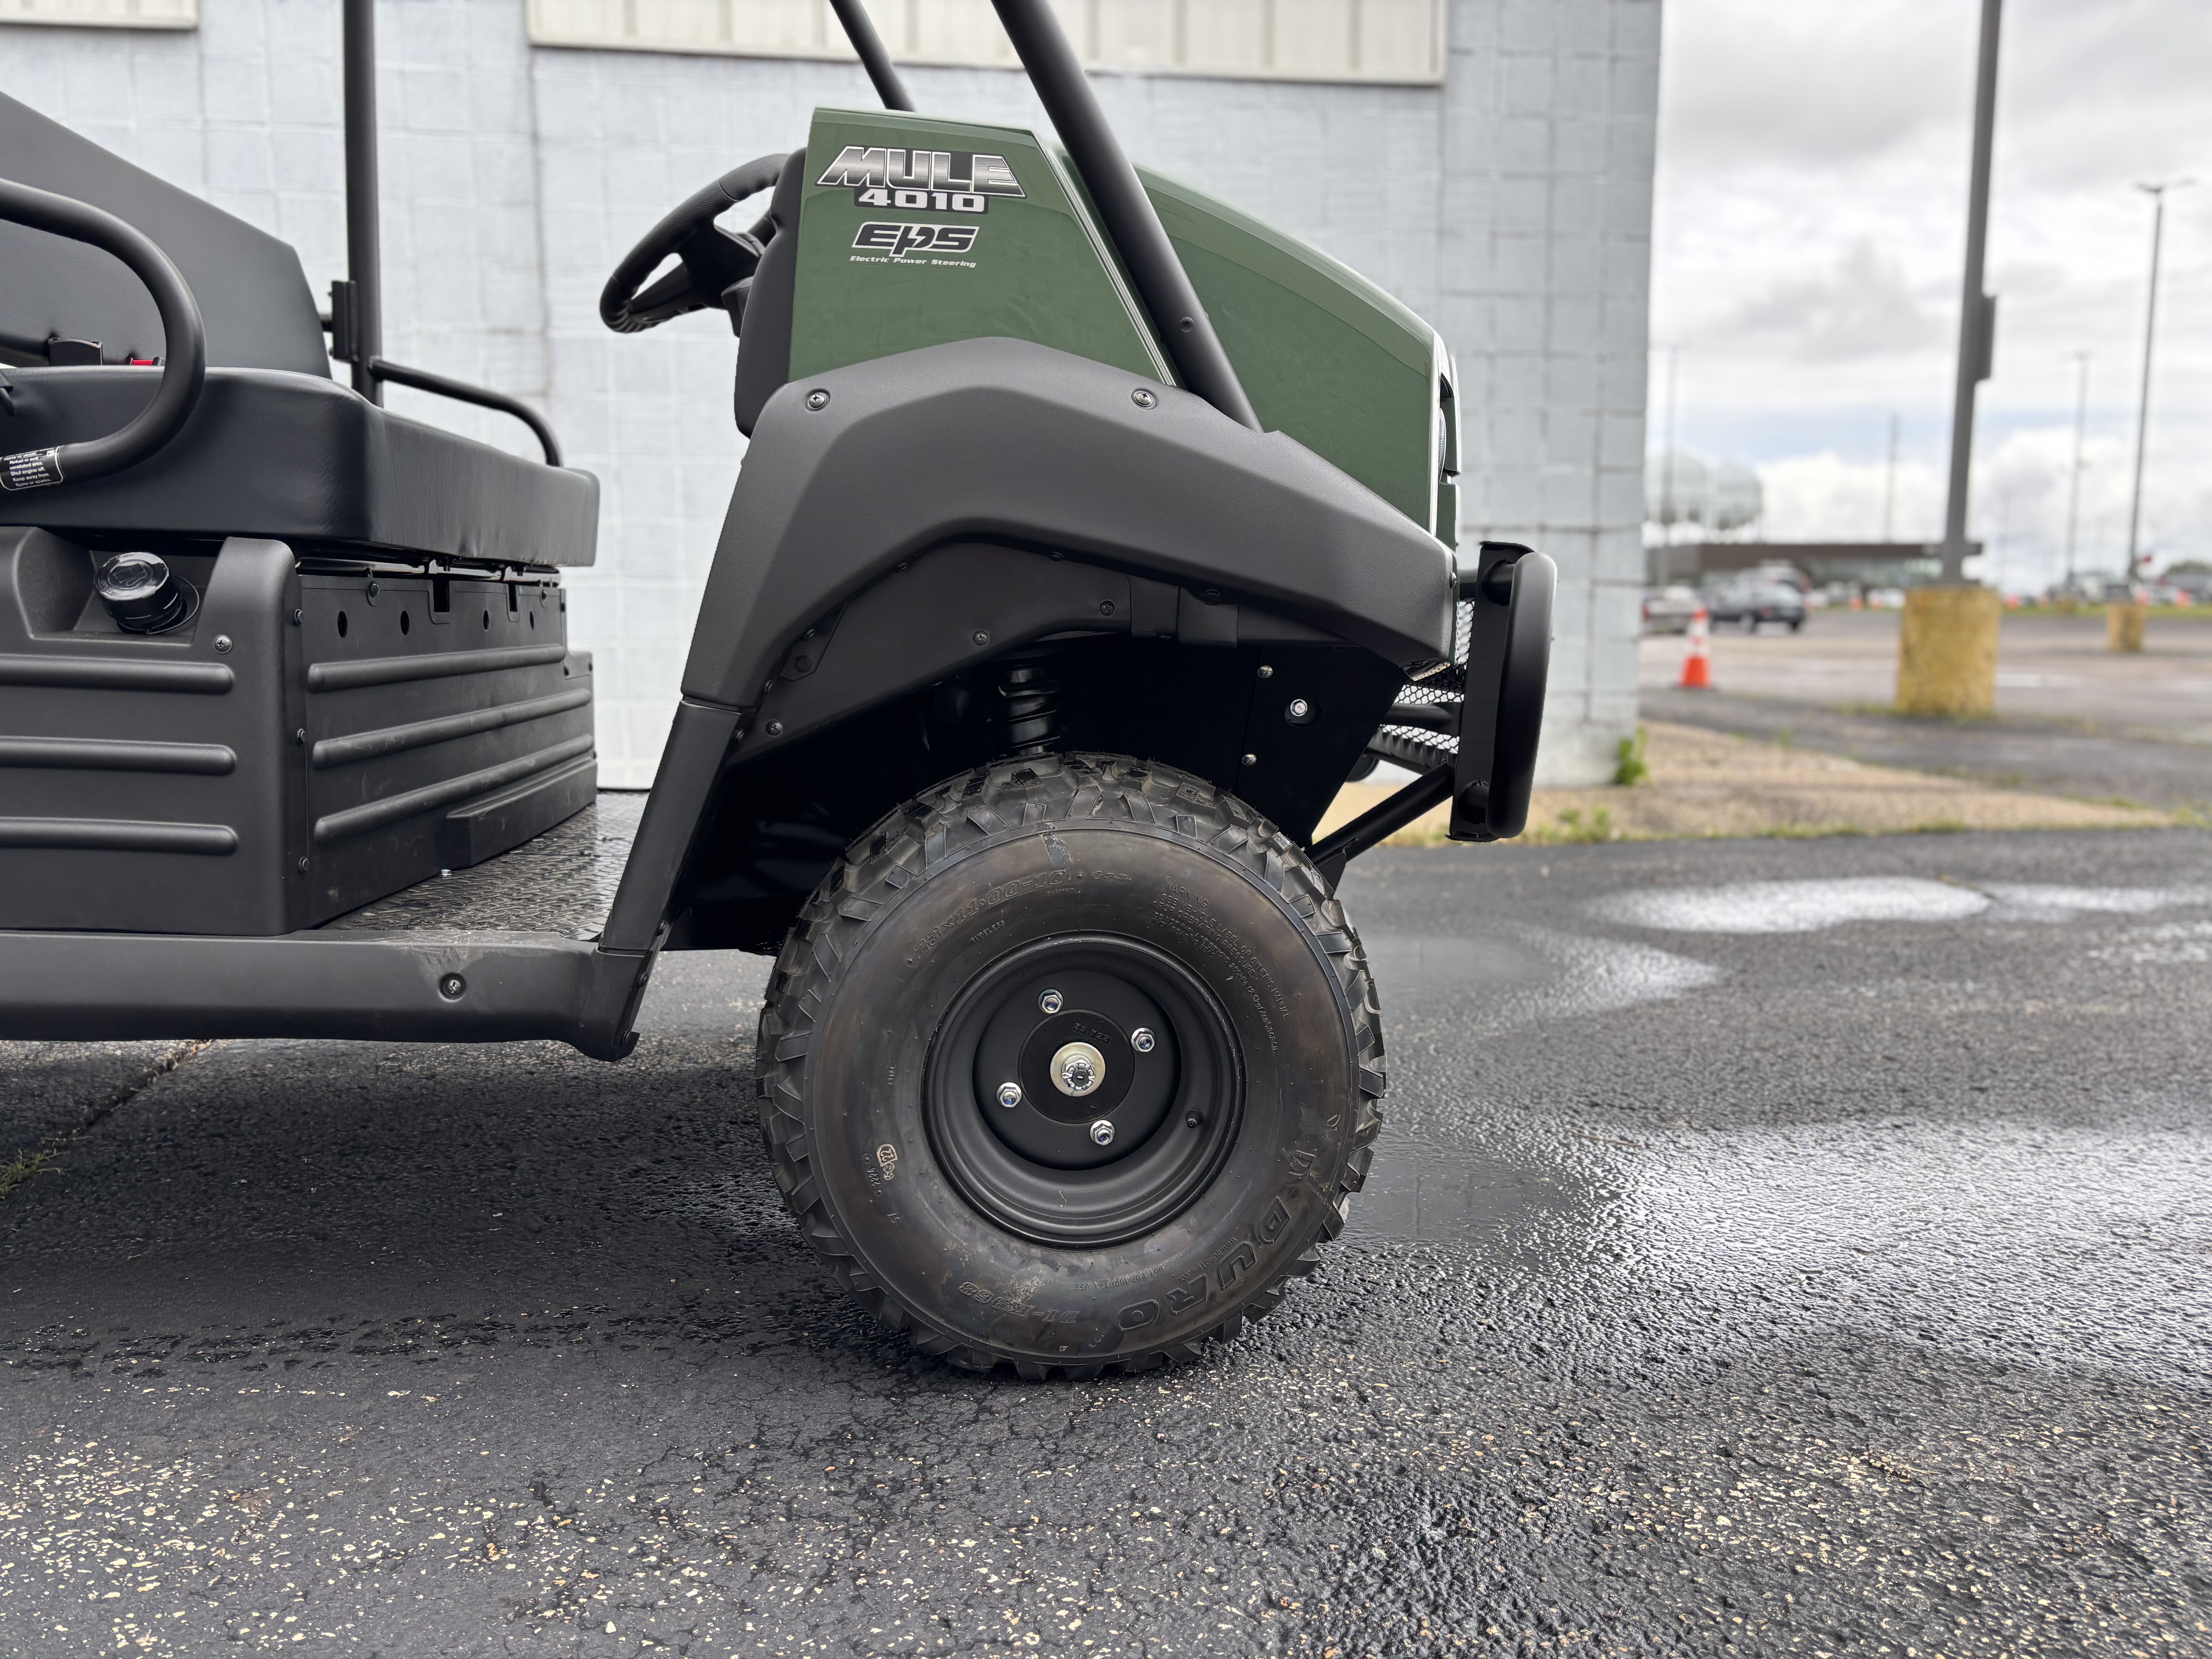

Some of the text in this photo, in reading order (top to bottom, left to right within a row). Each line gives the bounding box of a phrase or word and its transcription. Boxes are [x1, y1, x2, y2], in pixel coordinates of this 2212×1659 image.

[817, 146, 1026, 197] MULE
[859, 189, 985, 212] 4010
[852, 222, 980, 257] EPS
[893, 258, 927, 266] Power
[931, 259, 977, 268] Steering
[971, 920, 1006, 943] TUBELESS
[1161, 893, 1178, 905] SEE
[1182, 902, 1216, 926] VEHICLE
[1216, 924, 1238, 946] LABEL
[1118, 1196, 1291, 1331] DURO
[1130, 1272, 1147, 1283] FOR
